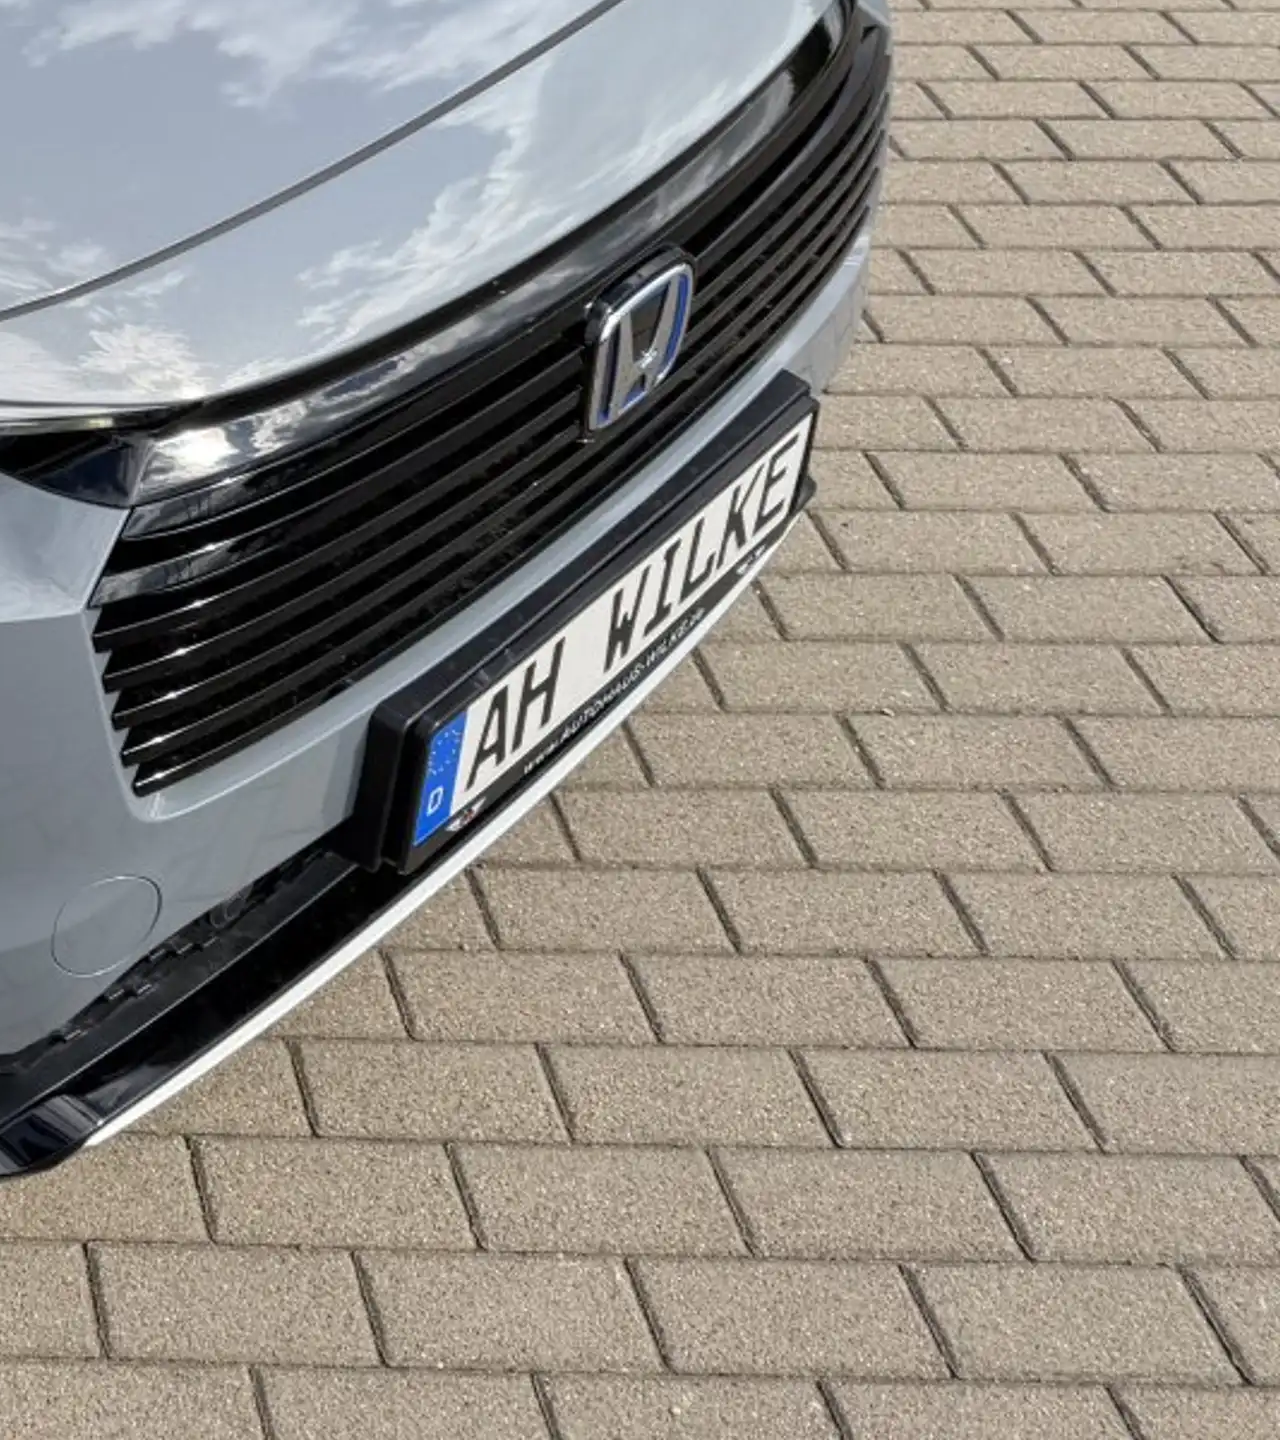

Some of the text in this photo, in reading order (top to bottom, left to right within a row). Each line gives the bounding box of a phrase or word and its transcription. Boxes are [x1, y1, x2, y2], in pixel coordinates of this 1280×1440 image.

[464, 433, 800, 792] AH WILKE
[425, 786, 443, 817] D
